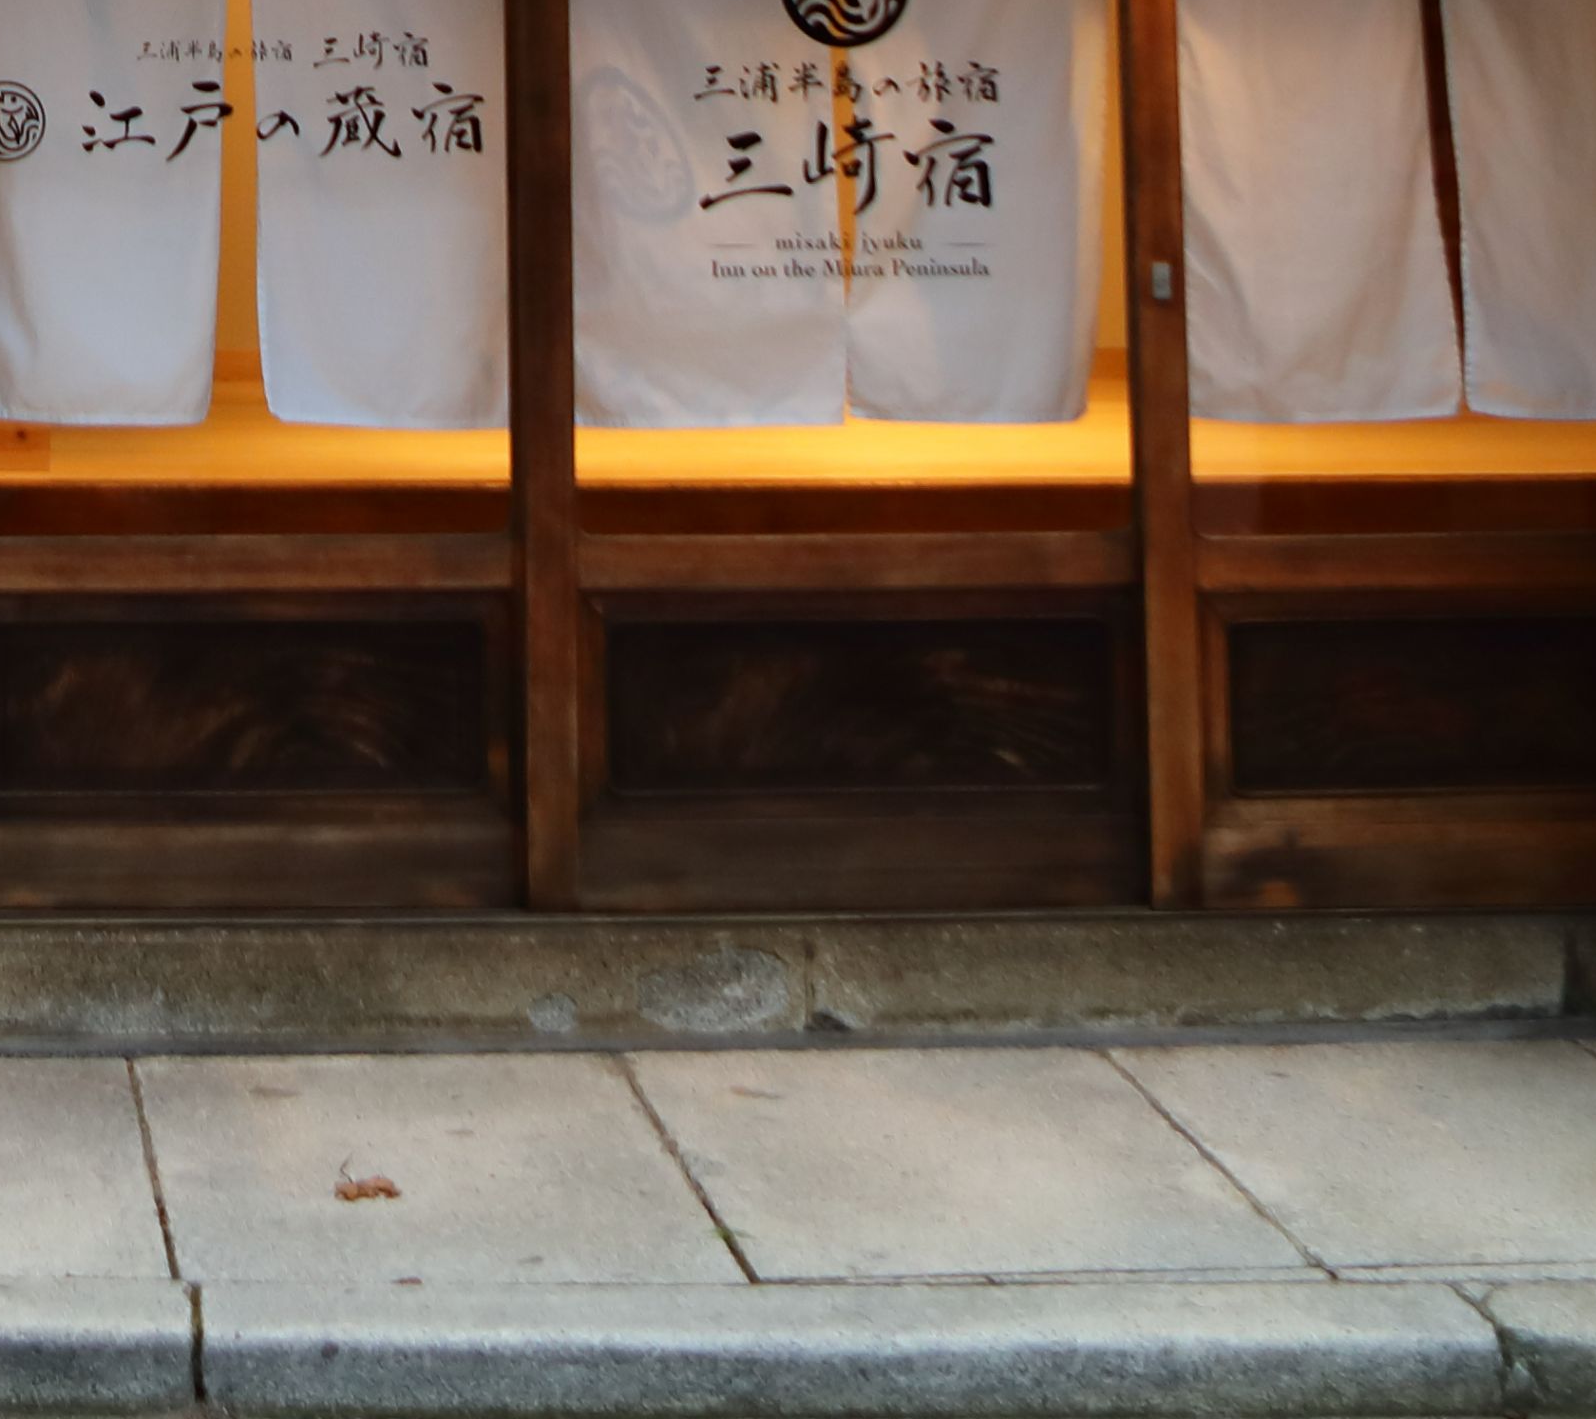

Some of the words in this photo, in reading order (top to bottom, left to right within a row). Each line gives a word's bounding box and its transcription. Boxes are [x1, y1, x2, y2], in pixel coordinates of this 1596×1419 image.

[313, 31, 429, 69] 三崎宿
[693, 60, 1000, 103] 三浦半島の旅宿
[82, 80, 485, 162] 江戸の蔵宿
[698, 114, 995, 216] 三崎宿
[774, 231, 850, 252] misaki
[711, 259, 747, 279] Inn
[751, 265, 777, 278] on
[783, 259, 818, 279] the
[822, 259, 885, 278] Miura
[892, 257, 991, 278] Peninsula
